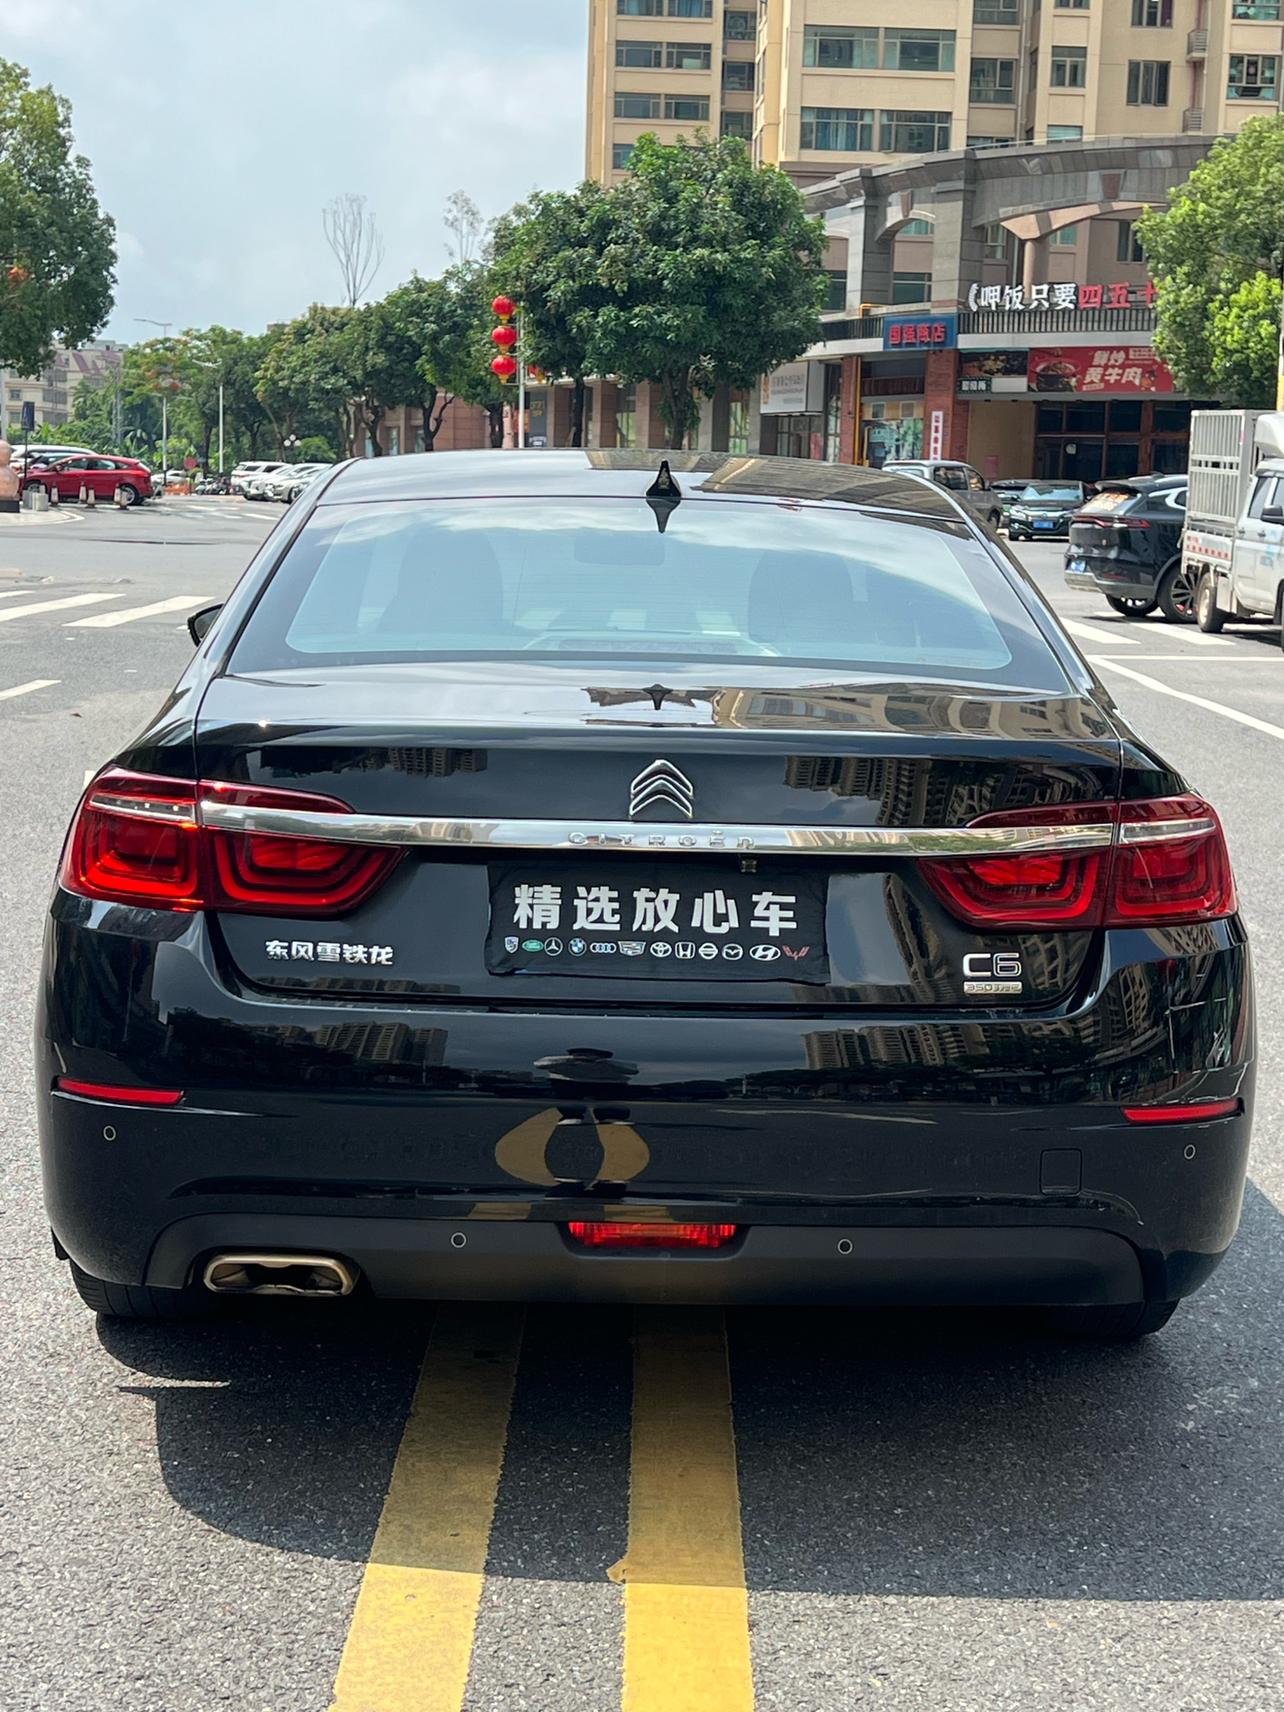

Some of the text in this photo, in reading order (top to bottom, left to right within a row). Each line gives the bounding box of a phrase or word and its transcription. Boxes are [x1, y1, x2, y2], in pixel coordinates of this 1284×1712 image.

[1083, 367, 1142, 385] 黄牛肉
[513, 884, 797, 936] 精选放心车
[265, 940, 393, 965] 东风雪铁龙
[963, 953, 1022, 977] C6
